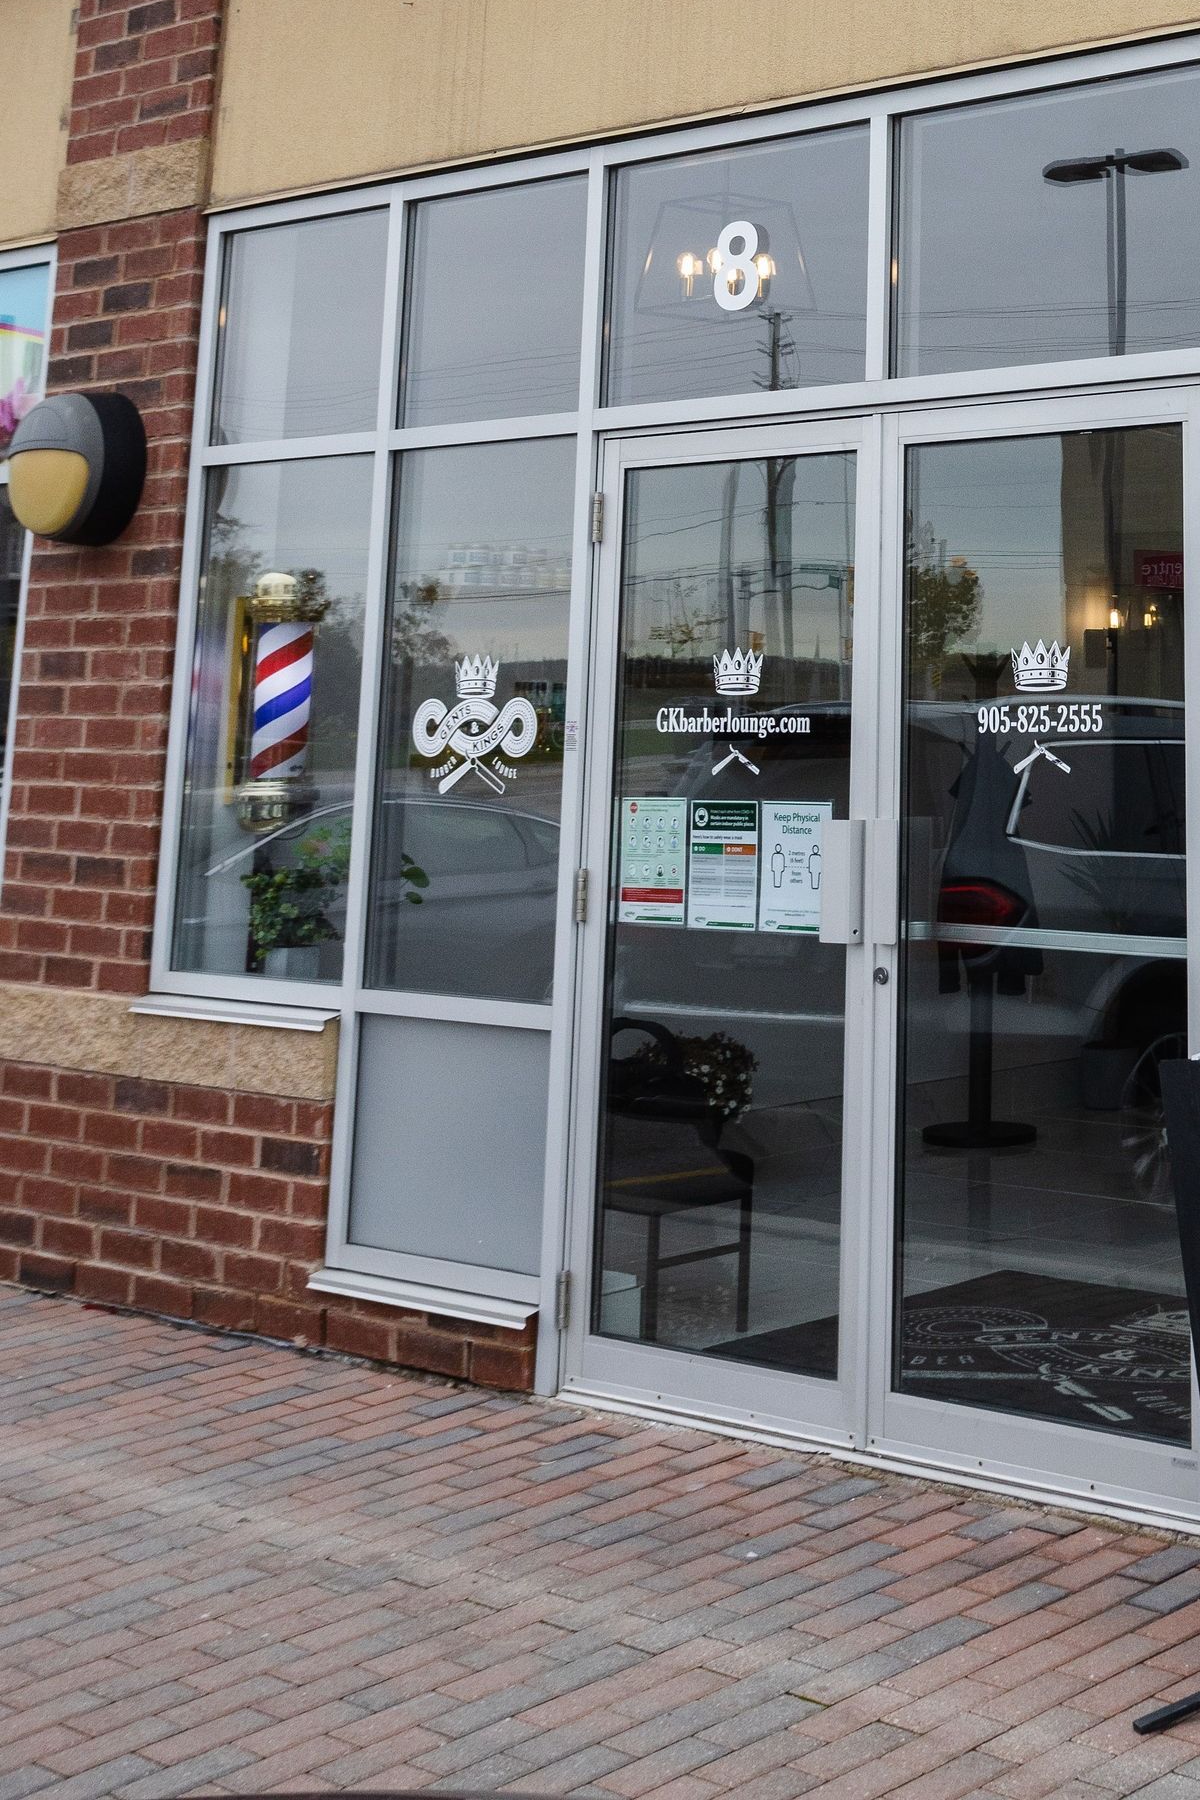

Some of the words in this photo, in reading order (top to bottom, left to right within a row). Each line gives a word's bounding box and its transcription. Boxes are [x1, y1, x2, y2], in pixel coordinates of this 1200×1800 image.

[714, 221, 760, 311] 8
[441, 705, 471, 739] GENTS
[470, 722, 479, 734] &
[656, 707, 811, 738] GKbarberlounge.com
[977, 704, 1103, 734] 905-825-2555
[472, 724, 504, 752] KINGS
[774, 812, 791, 823] Keep
[792, 812, 820, 824] Physical
[782, 825, 812, 835] Distance
[974, 1331, 1140, 1344] GENTS
[1099, 1349, 1140, 1361] &
